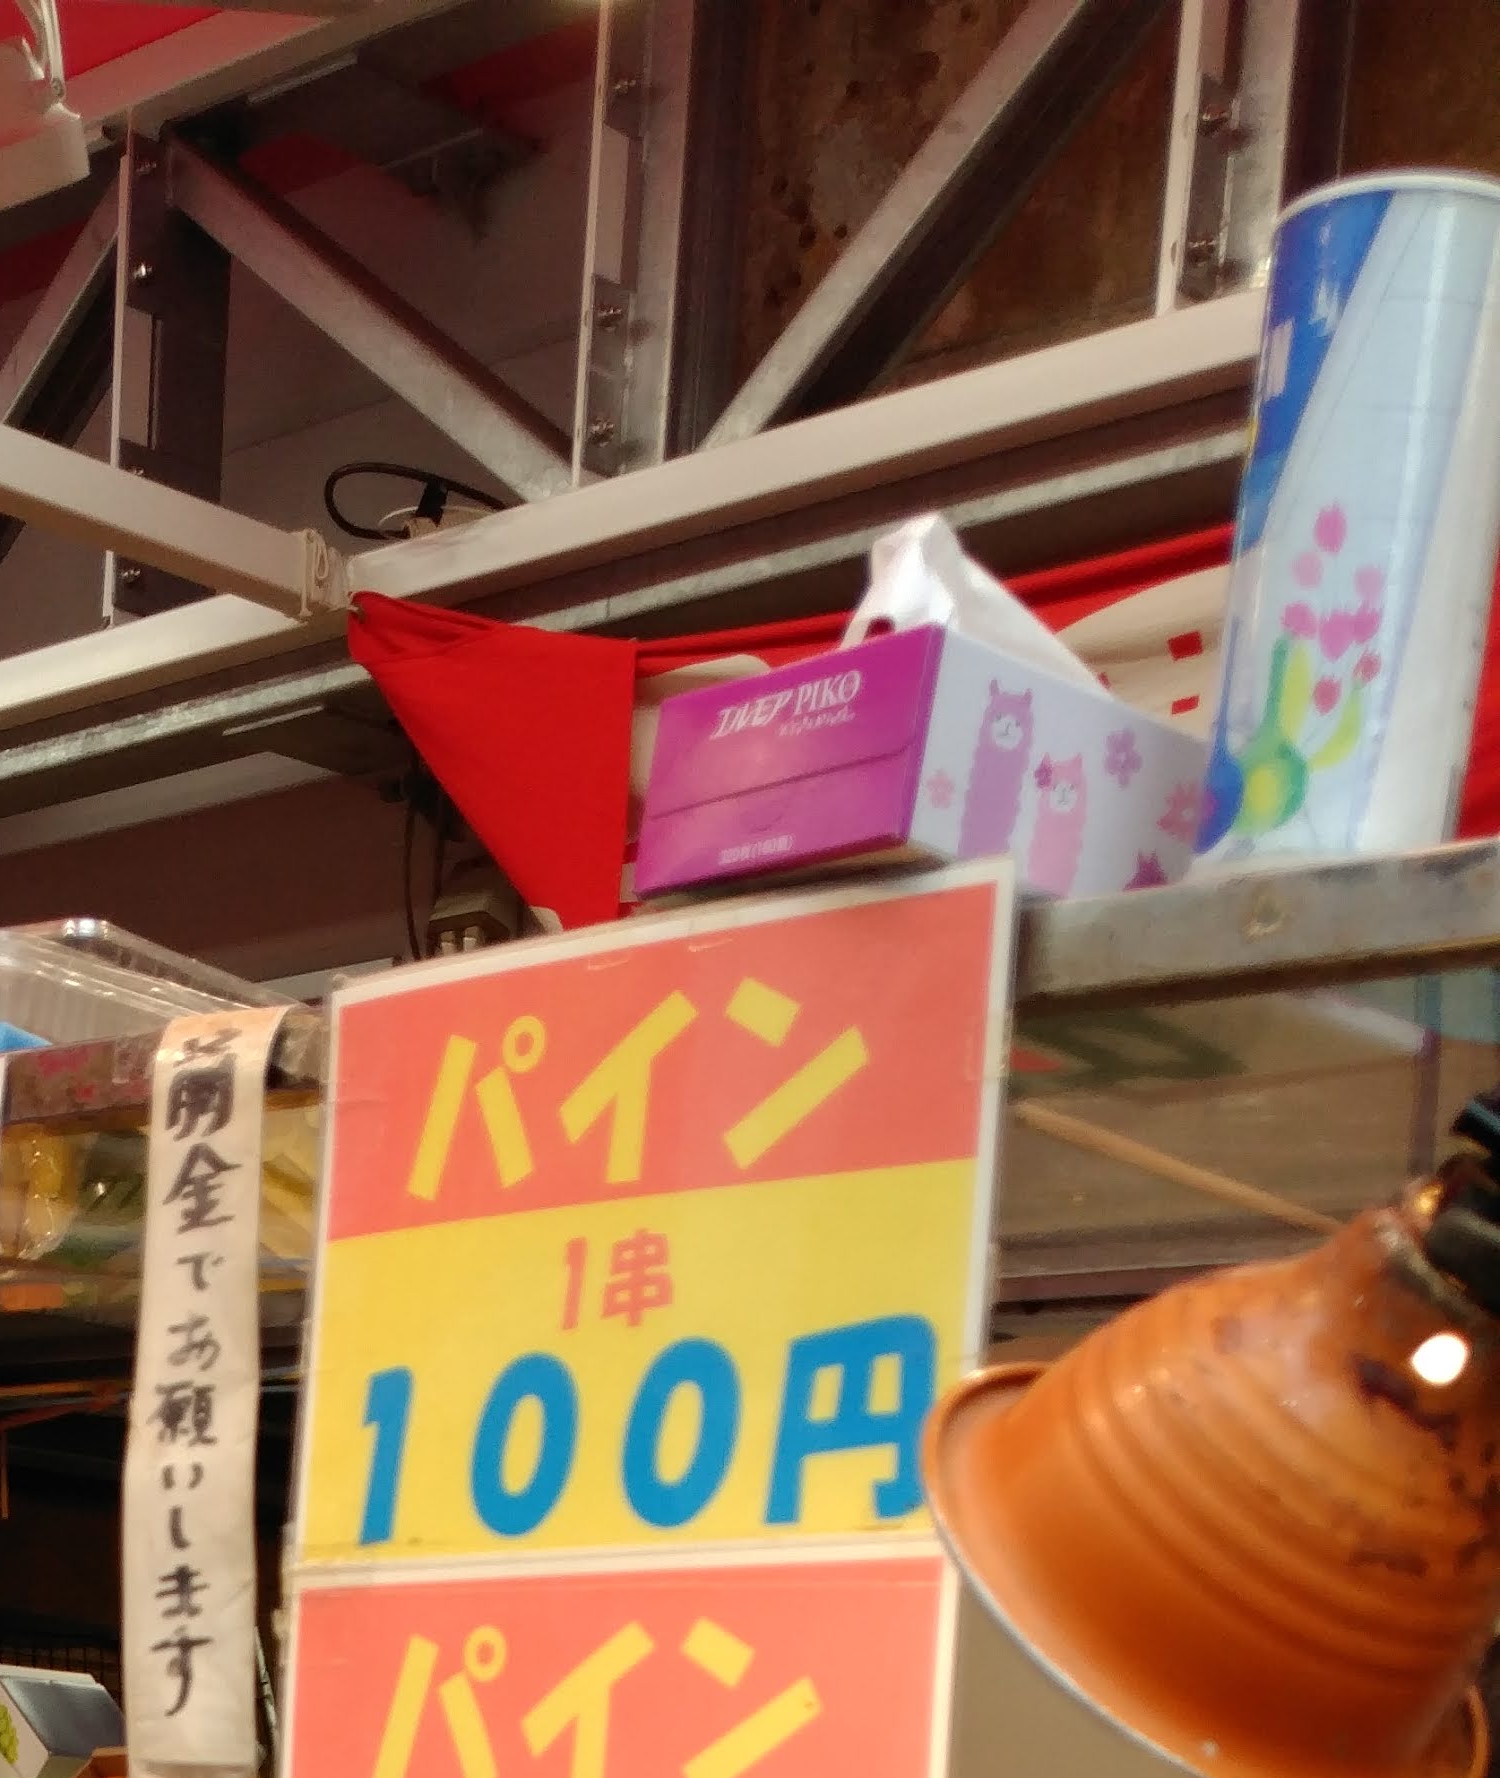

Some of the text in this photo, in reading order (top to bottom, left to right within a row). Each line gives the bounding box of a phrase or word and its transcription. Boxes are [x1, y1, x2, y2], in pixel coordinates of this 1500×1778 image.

[793, 669, 863, 720] PIKO
[409, 977, 868, 1202] パイン
[563, 1229, 673, 1331] 1串
[361, 1314, 935, 1545] 100円
